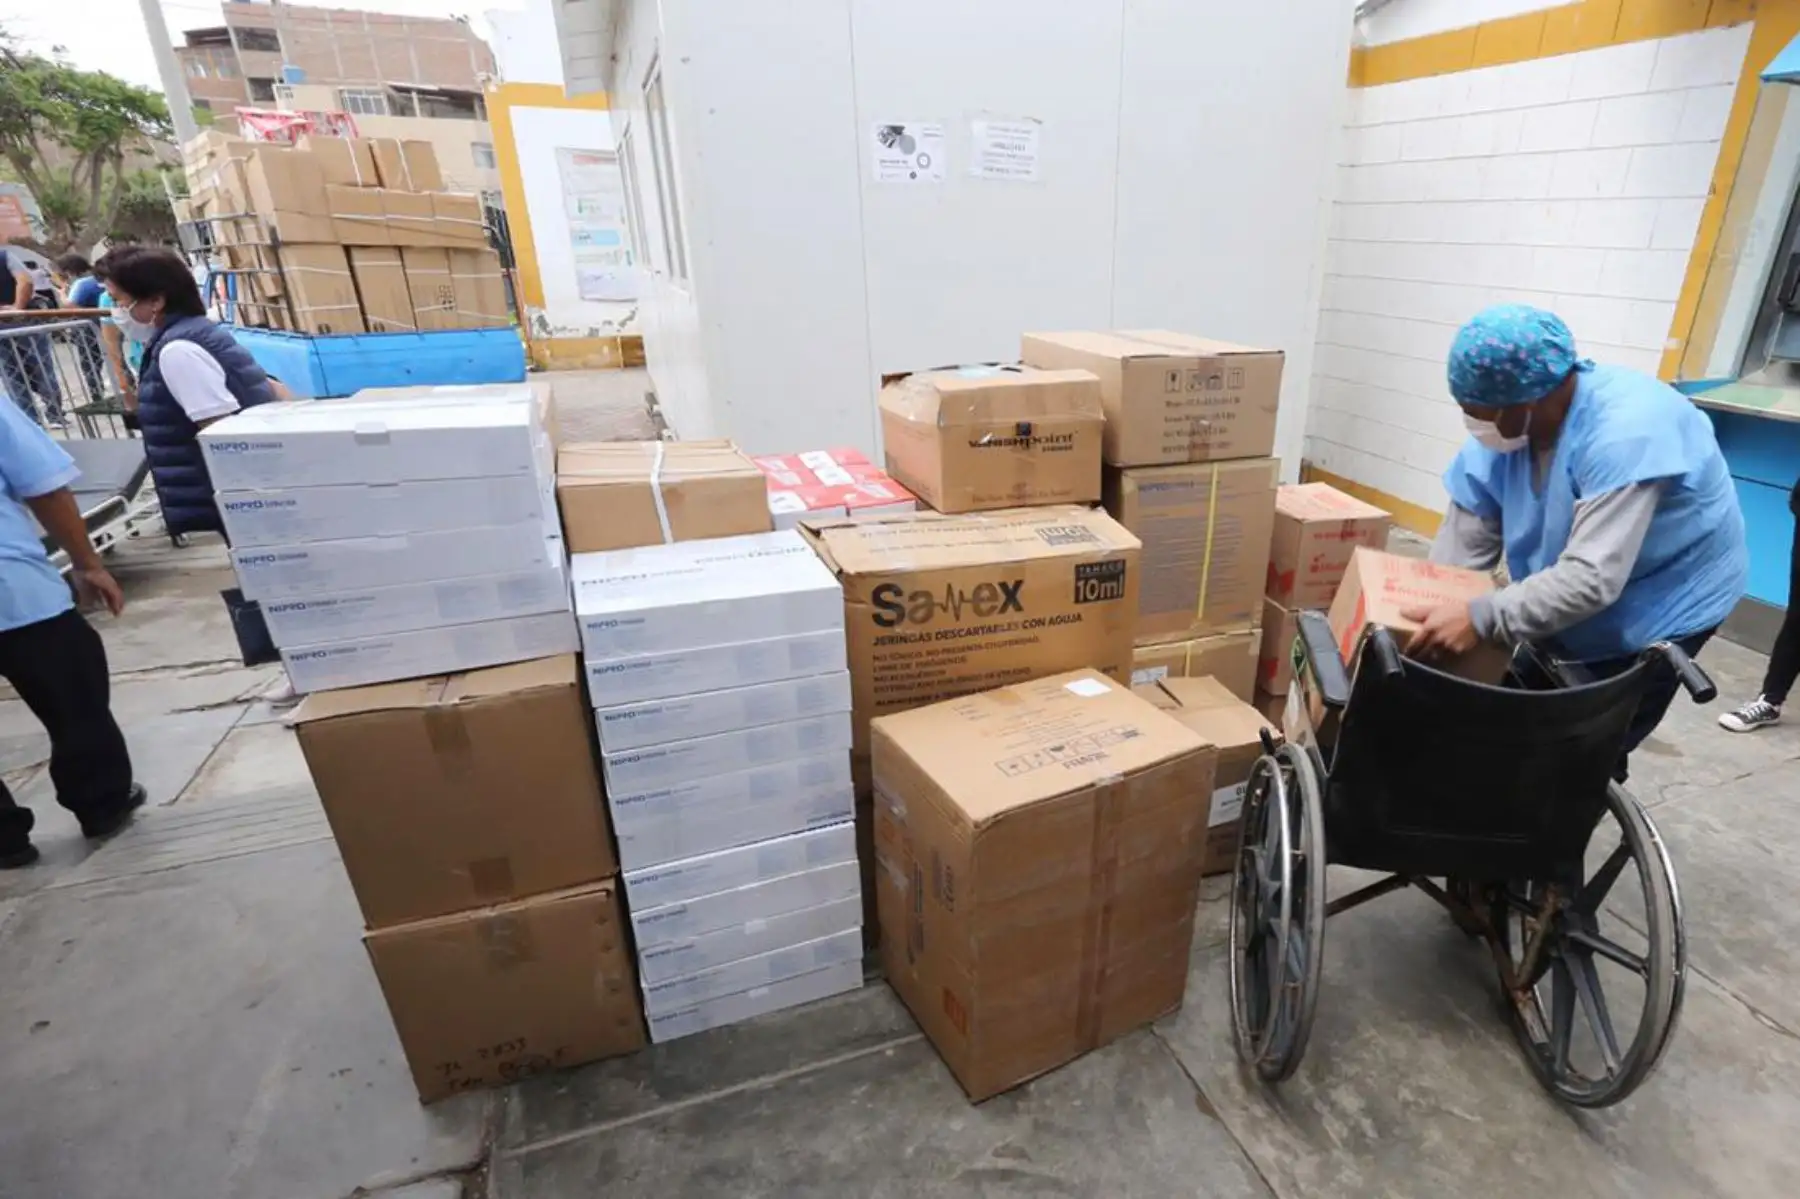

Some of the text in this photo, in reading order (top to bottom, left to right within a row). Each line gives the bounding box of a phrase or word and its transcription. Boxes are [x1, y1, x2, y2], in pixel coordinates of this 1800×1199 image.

[209, 441, 249, 452] NIPRO
[223, 500, 264, 511] NIPRO
[238, 553, 276, 565] NIPRO
[268, 601, 306, 613] NIPRO
[587, 618, 618, 630] NIPRO
[872, 611, 1083, 646] JERINGAS DESCARTABLES CON AGUJA
[289, 650, 327, 661] NIPRO
[593, 664, 625, 675] NIPRO
